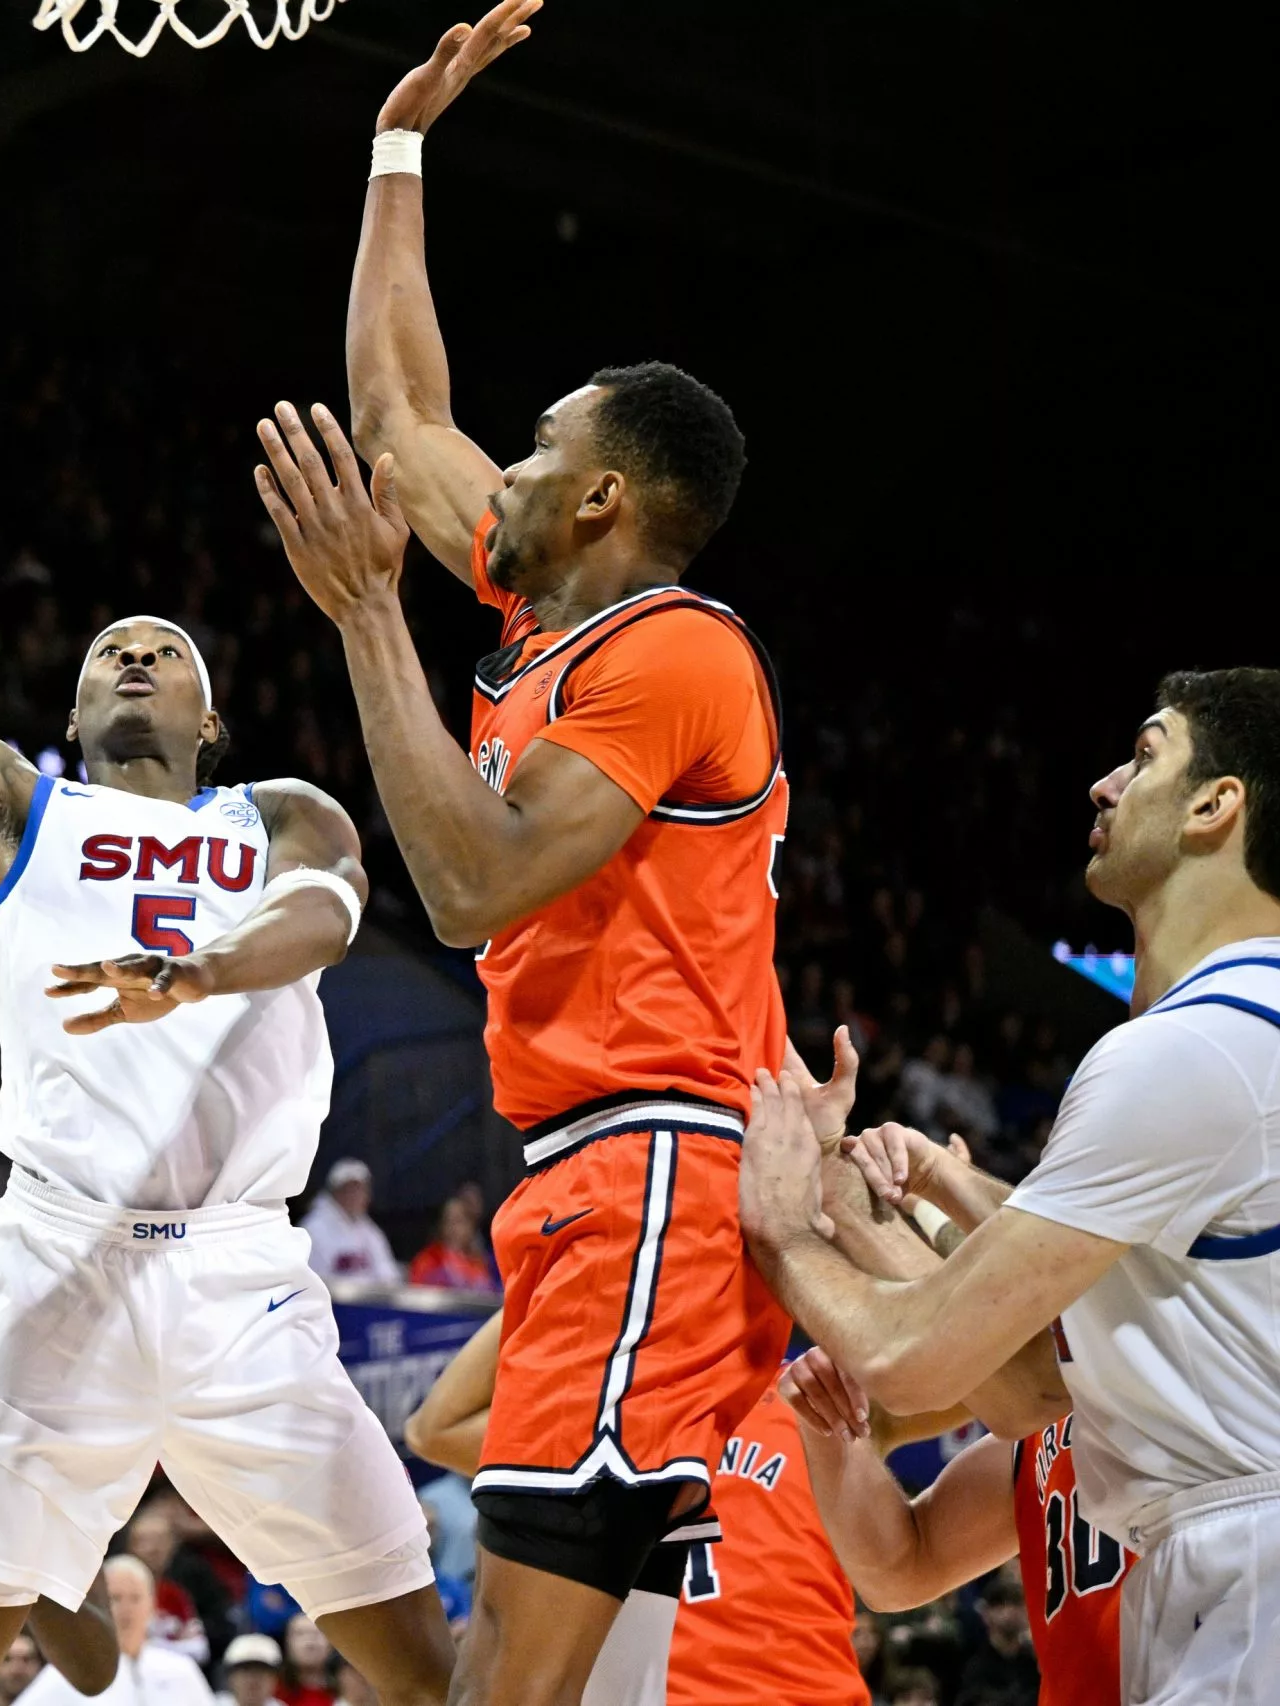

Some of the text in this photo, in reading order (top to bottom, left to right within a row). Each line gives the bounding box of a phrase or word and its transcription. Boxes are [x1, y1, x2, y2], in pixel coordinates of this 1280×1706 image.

[79, 833, 257, 892] SMU
[131, 893, 197, 957] 5
[132, 1222, 186, 1239] SMU
[716, 1436, 788, 1492] NIA
